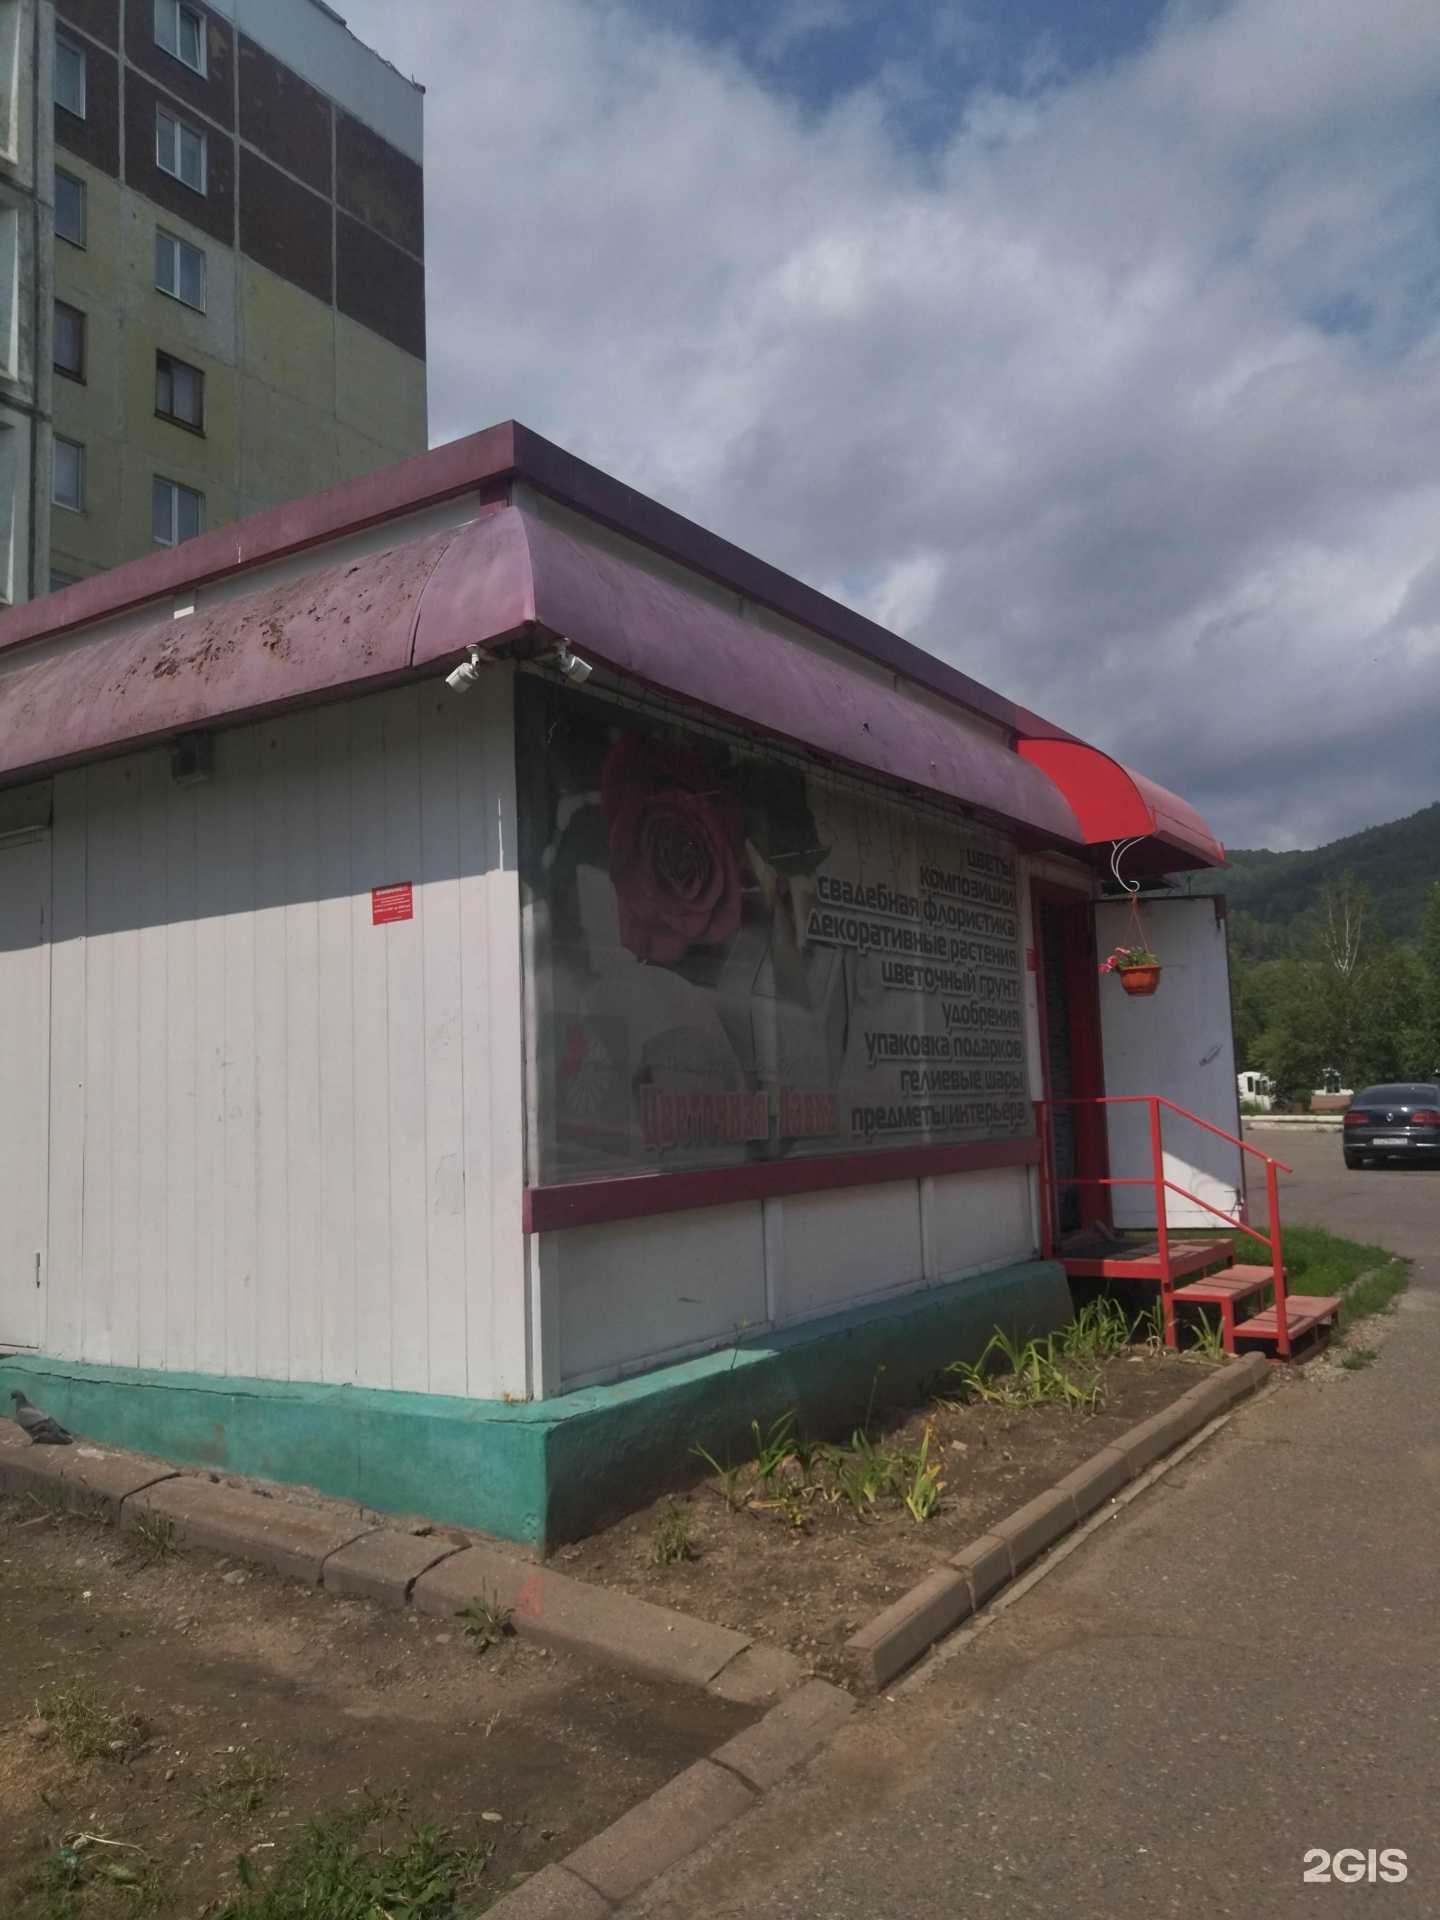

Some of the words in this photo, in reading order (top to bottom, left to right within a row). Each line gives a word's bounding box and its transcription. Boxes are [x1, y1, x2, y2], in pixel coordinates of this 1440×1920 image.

[919, 863, 1016, 908] композиции
[818, 875, 919, 915] свадебная
[923, 895, 1016, 936] флористика
[808, 911, 947, 953] декоративные
[950, 939, 1017, 967] растения
[881, 960, 975, 993] цветочный
[979, 975, 1018, 999] грунт
[942, 1001, 1020, 1028] удобрения
[864, 1031, 950, 1058] упаковка
[953, 1037, 1022, 1060] подарков
[900, 1070, 982, 1092] гелиевые
[985, 1071, 1024, 1093] шары
